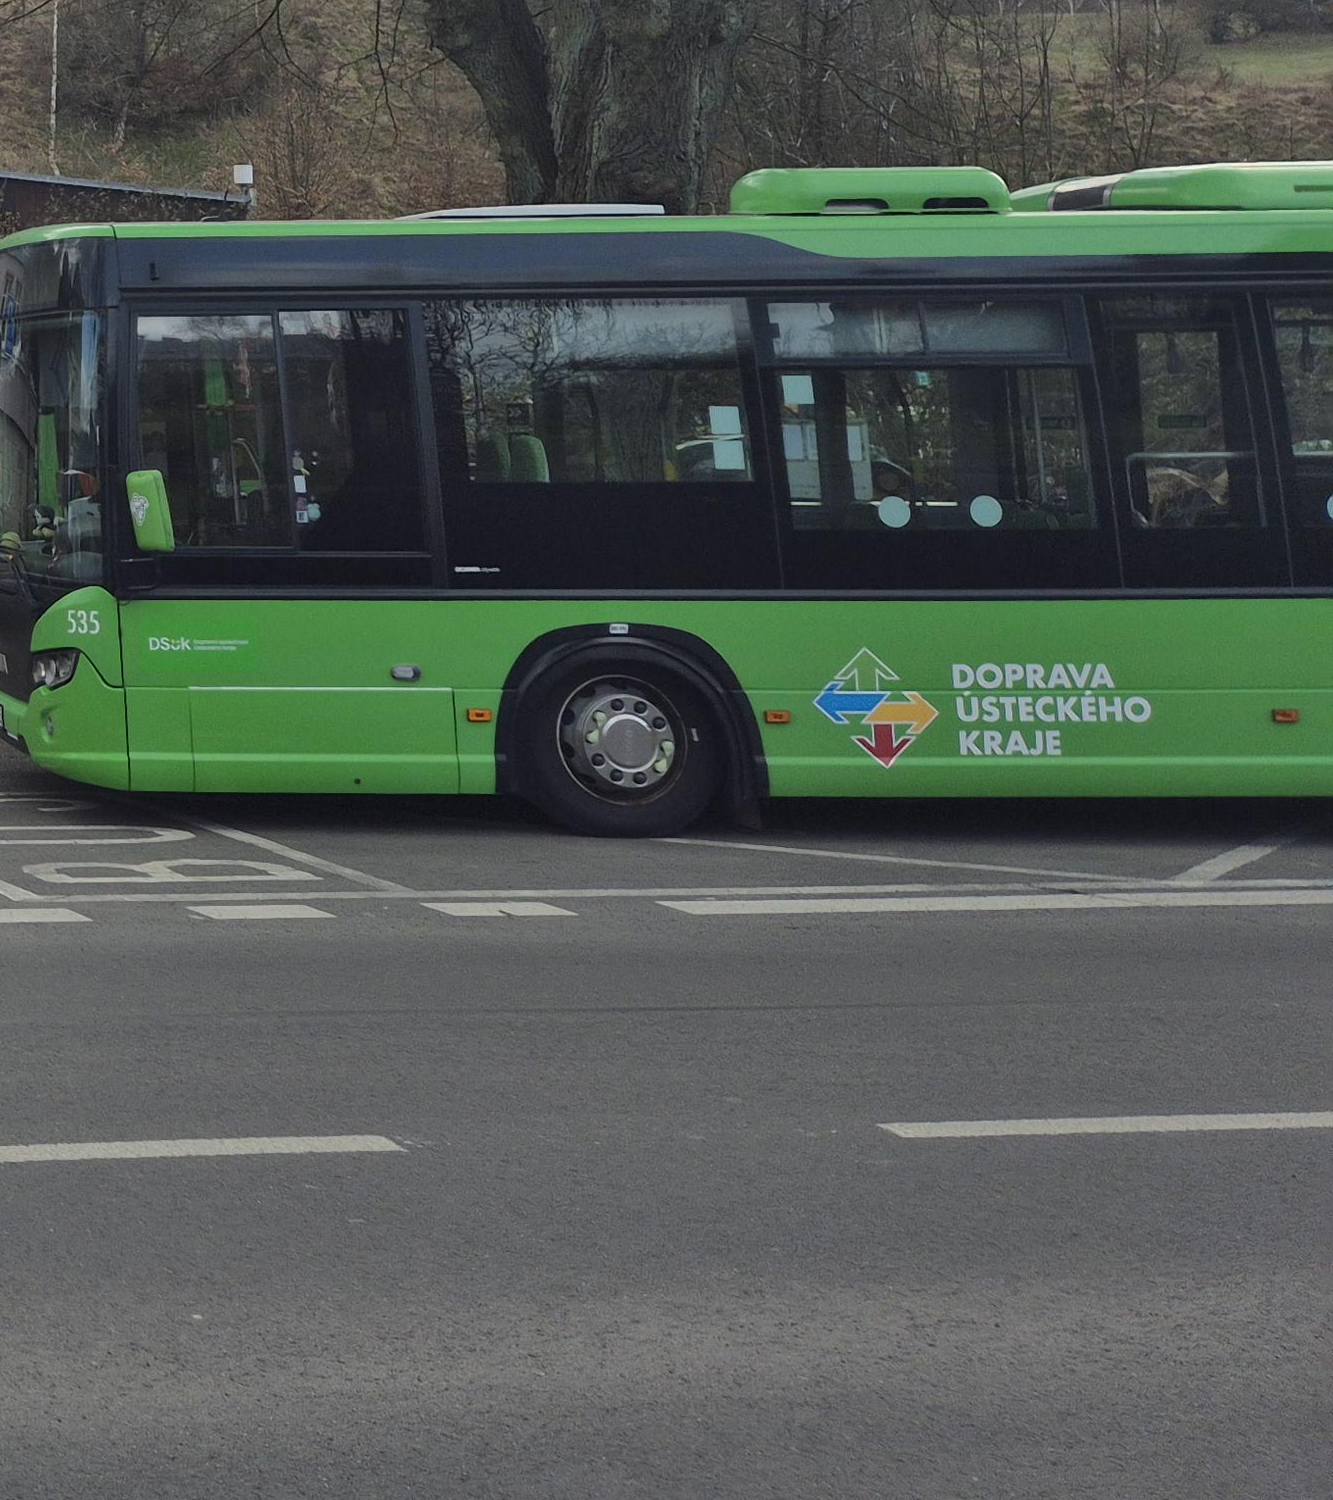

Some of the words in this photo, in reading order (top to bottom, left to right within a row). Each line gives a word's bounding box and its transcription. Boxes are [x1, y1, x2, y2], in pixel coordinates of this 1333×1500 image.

[67, 610, 100, 634] 535
[952, 663, 1115, 689] DOPRAVA
[956, 690, 1152, 723] ÚSTECKÉHO
[959, 730, 1062, 756] KRAJE
